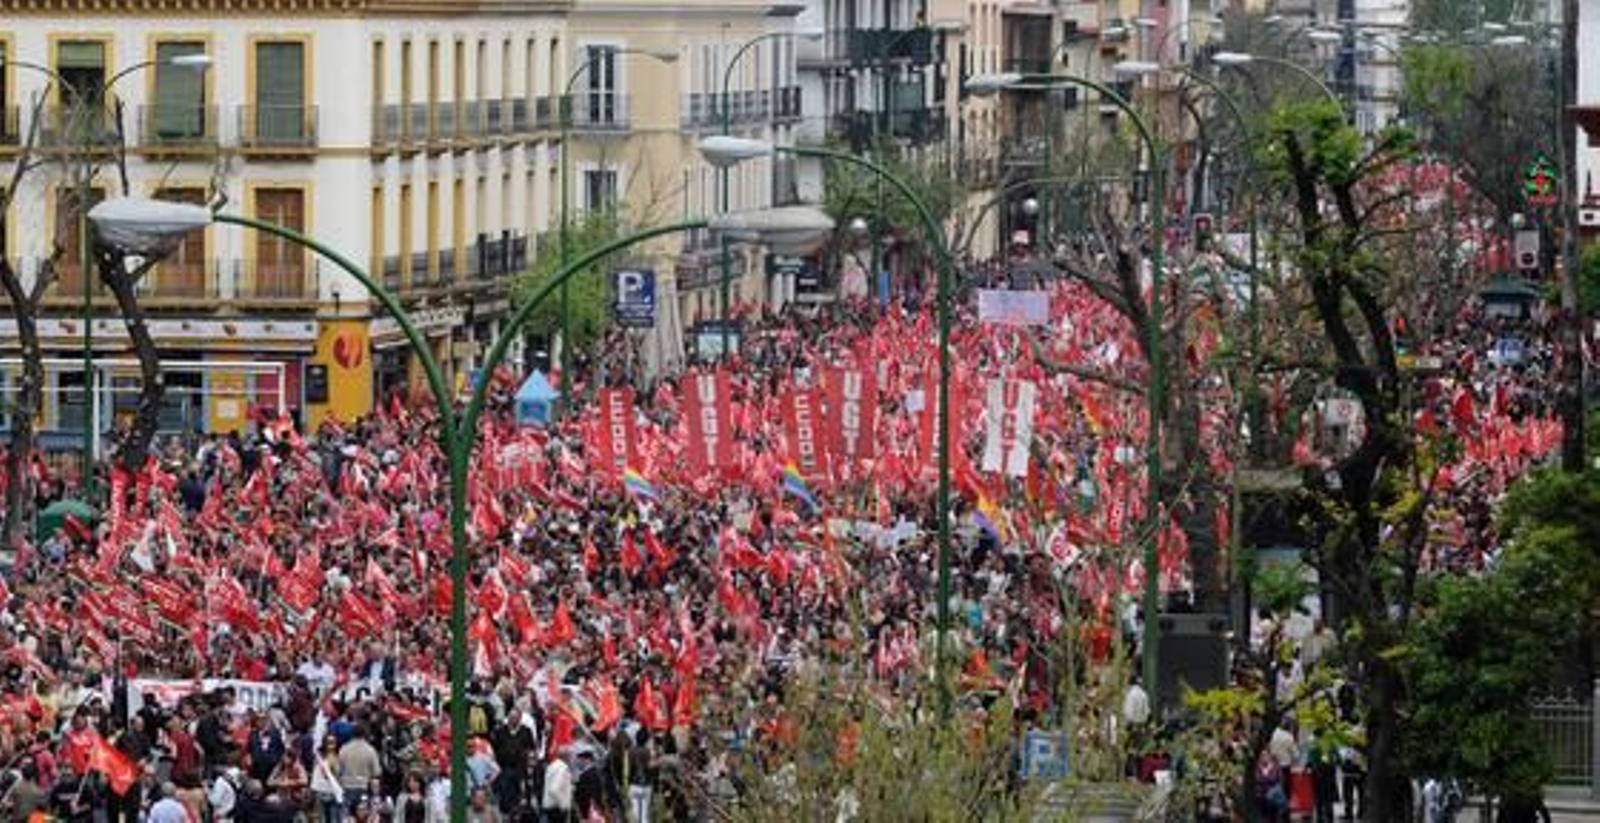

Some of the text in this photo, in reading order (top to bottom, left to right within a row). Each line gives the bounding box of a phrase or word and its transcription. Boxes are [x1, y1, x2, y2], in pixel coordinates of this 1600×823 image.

[618, 272, 644, 302] P
[697, 374, 719, 465] UGT
[842, 370, 862, 454] UGT
[1001, 381, 1019, 471] UGT
